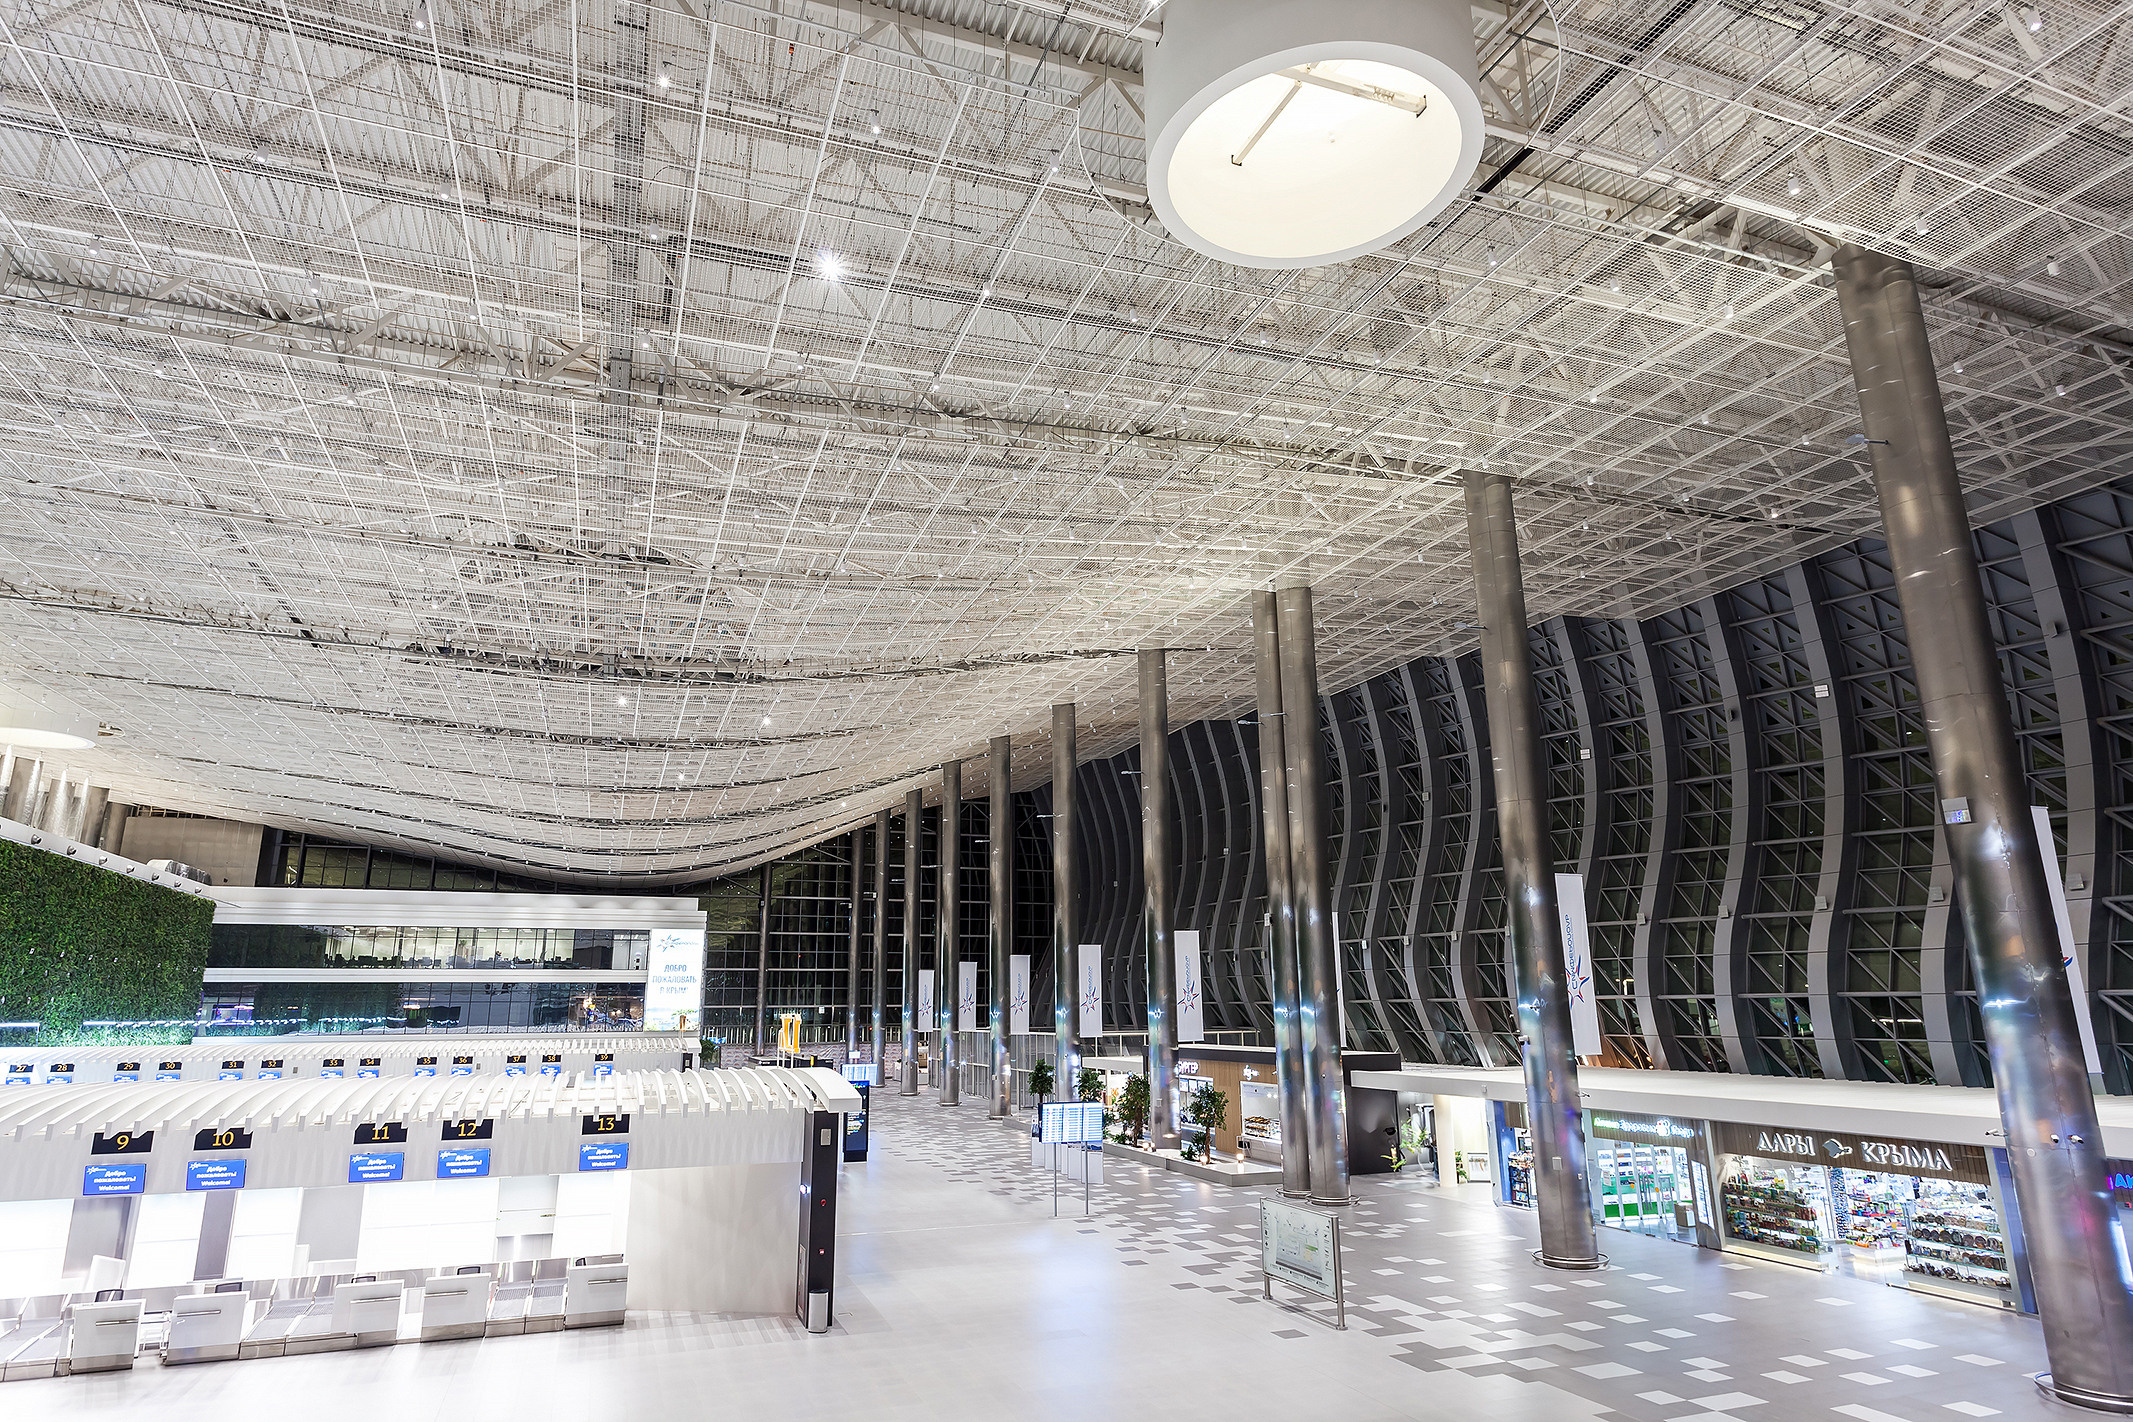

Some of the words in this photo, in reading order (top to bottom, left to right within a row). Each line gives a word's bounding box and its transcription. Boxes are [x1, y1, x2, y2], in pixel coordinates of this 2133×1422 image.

[664, 964, 687, 973] ДОБРО
[652, 975, 697, 983] ПОЖАЛОВАТЬ
[329, 1059, 338, 1067] 33
[365, 1058, 375, 1066] 34
[512, 1055, 521, 1063] 37
[56, 1064, 68, 1072] 28
[123, 1063, 134, 1071] 29
[165, 1062, 176, 1070] 30
[267, 1060, 277, 1068] 32
[597, 1117, 615, 1131] 13
[371, 1125, 390, 1140] 11
[457, 1122, 477, 1137] 12
[116, 1134, 130, 1151] 9
[212, 1131, 235, 1147] 10
[1757, 1131, 1816, 1156] ДАРЫ
[1860, 1141, 1952, 1171] КРЫМА
